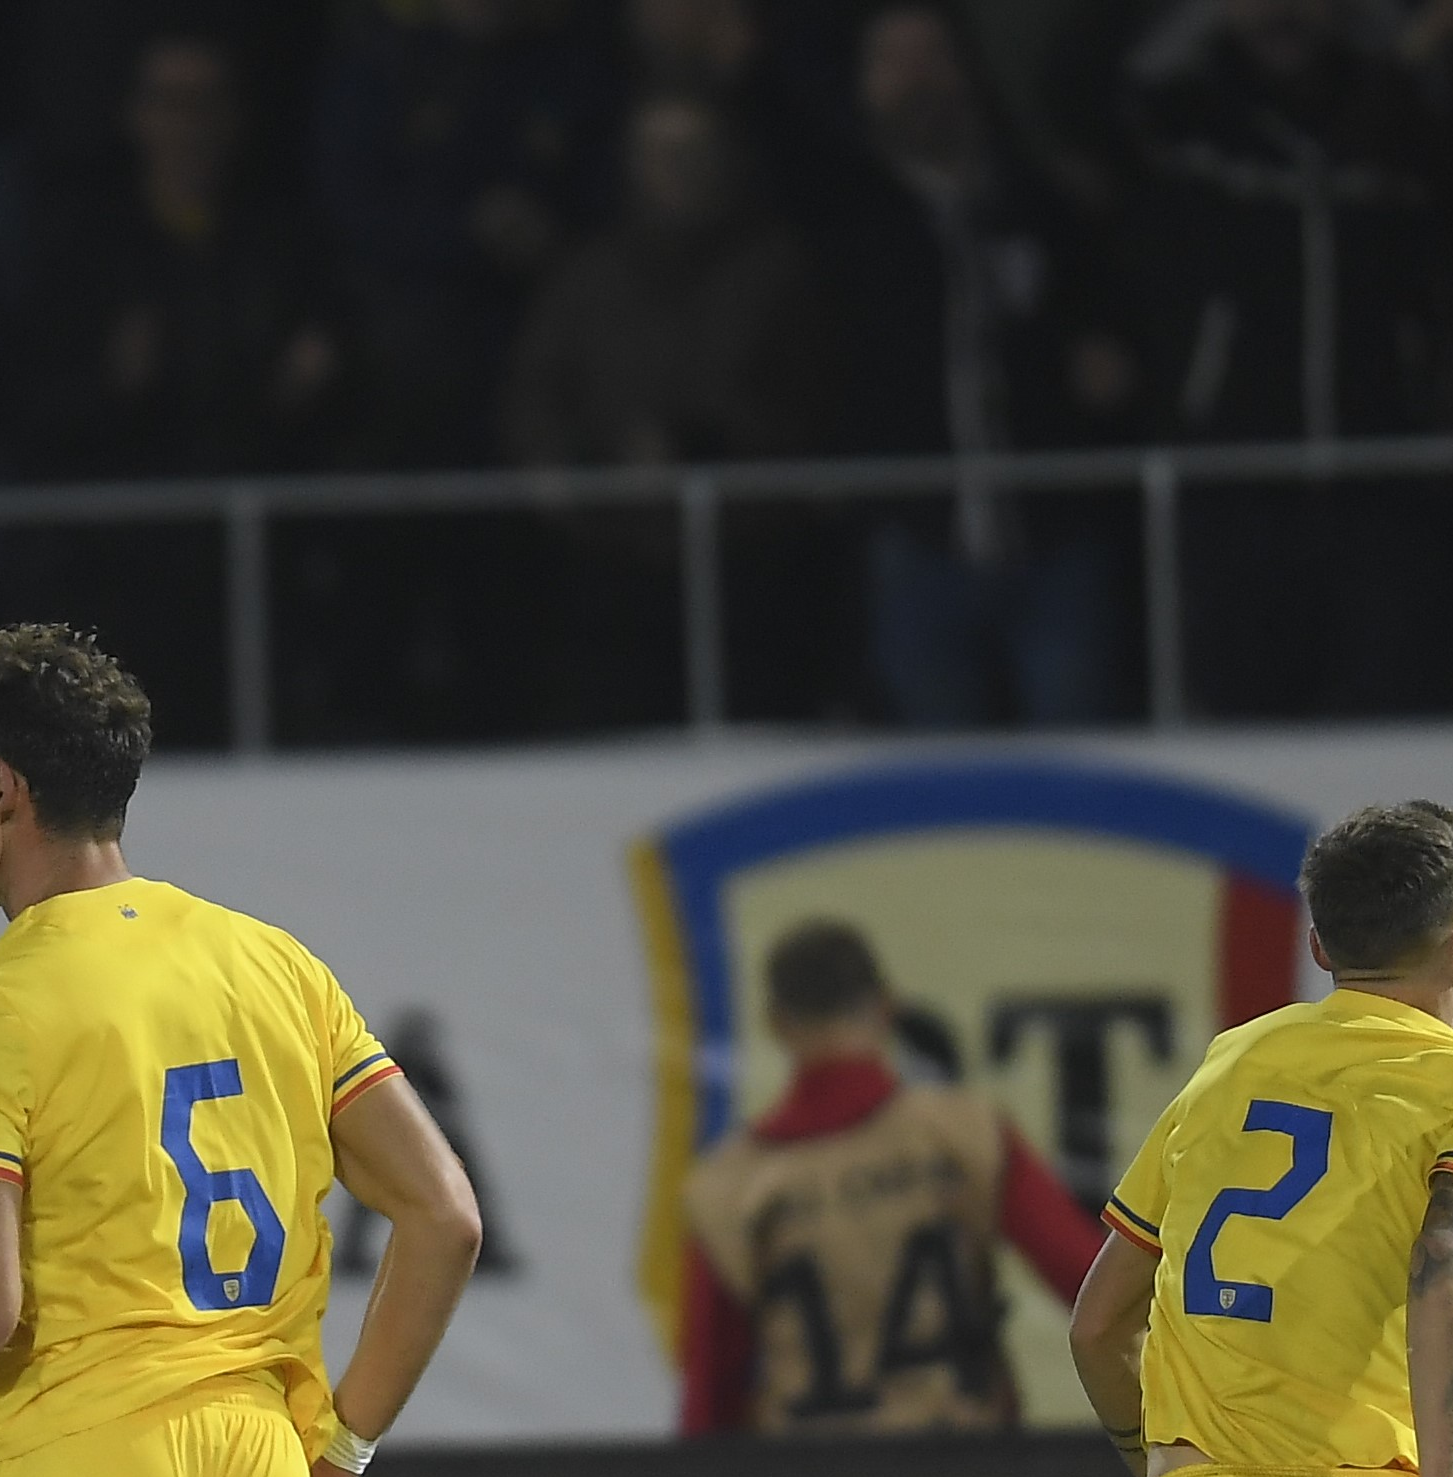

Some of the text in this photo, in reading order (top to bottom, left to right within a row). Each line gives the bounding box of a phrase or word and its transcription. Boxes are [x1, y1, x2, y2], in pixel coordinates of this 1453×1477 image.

[159, 1058, 286, 1311] 6
[1183, 1099, 1334, 1324] 2
[760, 1212, 1016, 1418] 14
